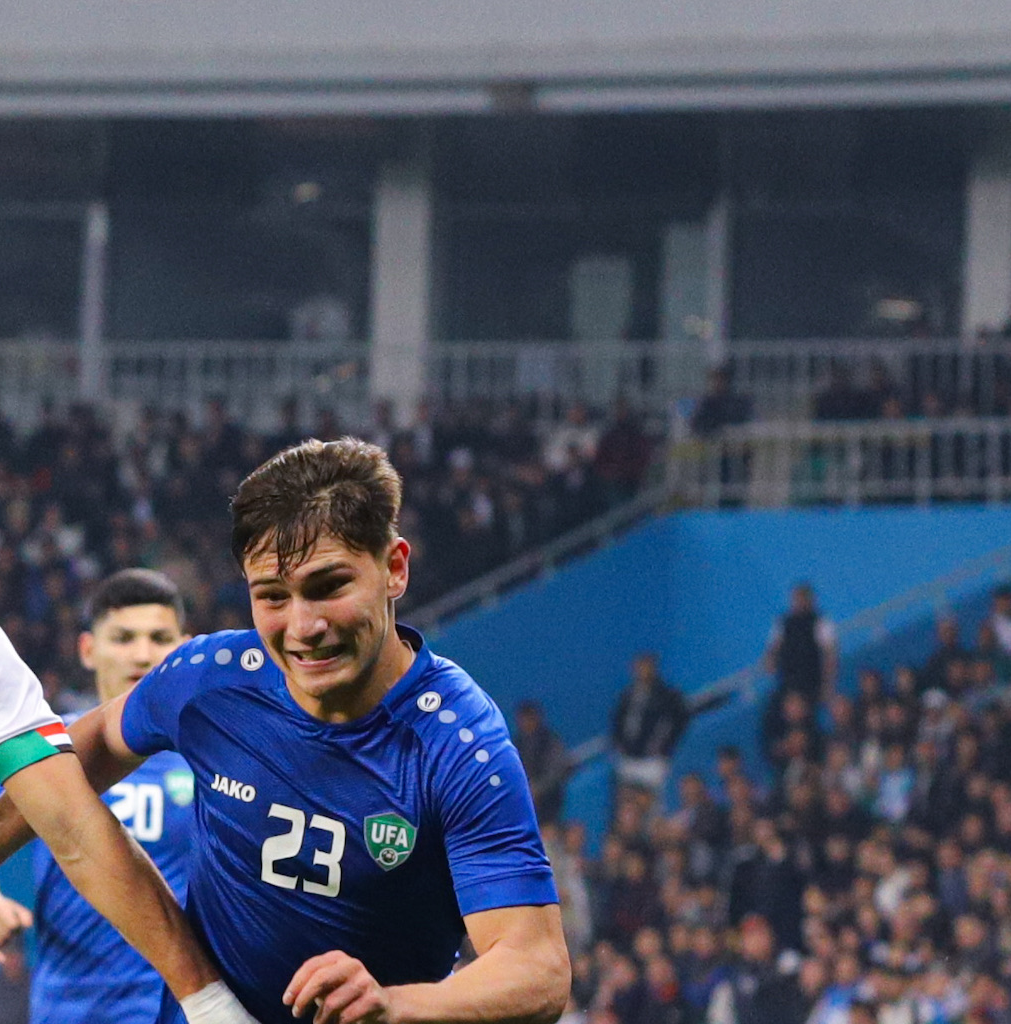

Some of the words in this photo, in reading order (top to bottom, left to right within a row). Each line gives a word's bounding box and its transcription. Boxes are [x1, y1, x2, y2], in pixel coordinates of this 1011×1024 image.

[211, 773, 257, 803] JAKO
[107, 782, 164, 842] 20
[261, 803, 347, 898] 23
[371, 822, 408, 848] UFA
